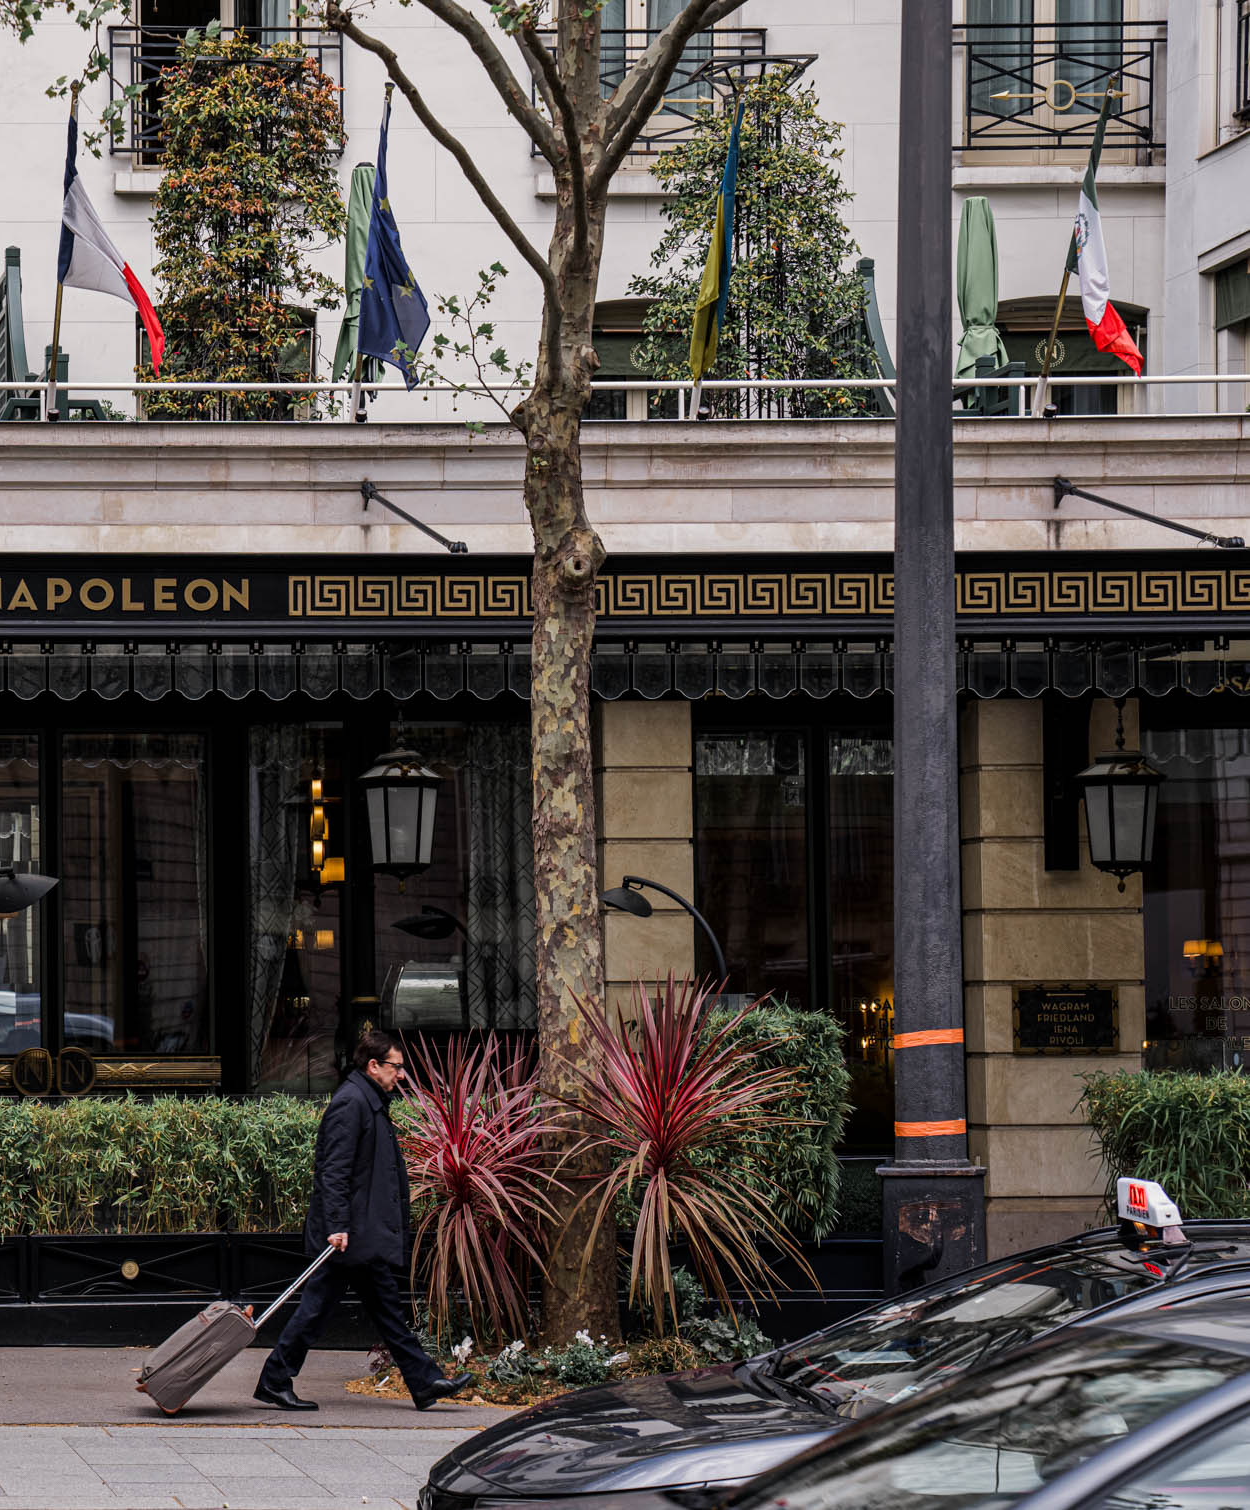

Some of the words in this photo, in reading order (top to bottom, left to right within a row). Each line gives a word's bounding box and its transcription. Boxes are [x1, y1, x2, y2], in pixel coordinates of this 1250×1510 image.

[1041, 1002, 1090, 1012] WAGRAM
[1168, 995, 1198, 1011] LES
[1037, 1013, 1095, 1023] FRIEDLAND
[1205, 1015, 1229, 1031] DE
[1049, 1034, 1085, 1046] RIVOLI
[62, 1059, 86, 1085] N
[1129, 1184, 1147, 1208] TAXI
